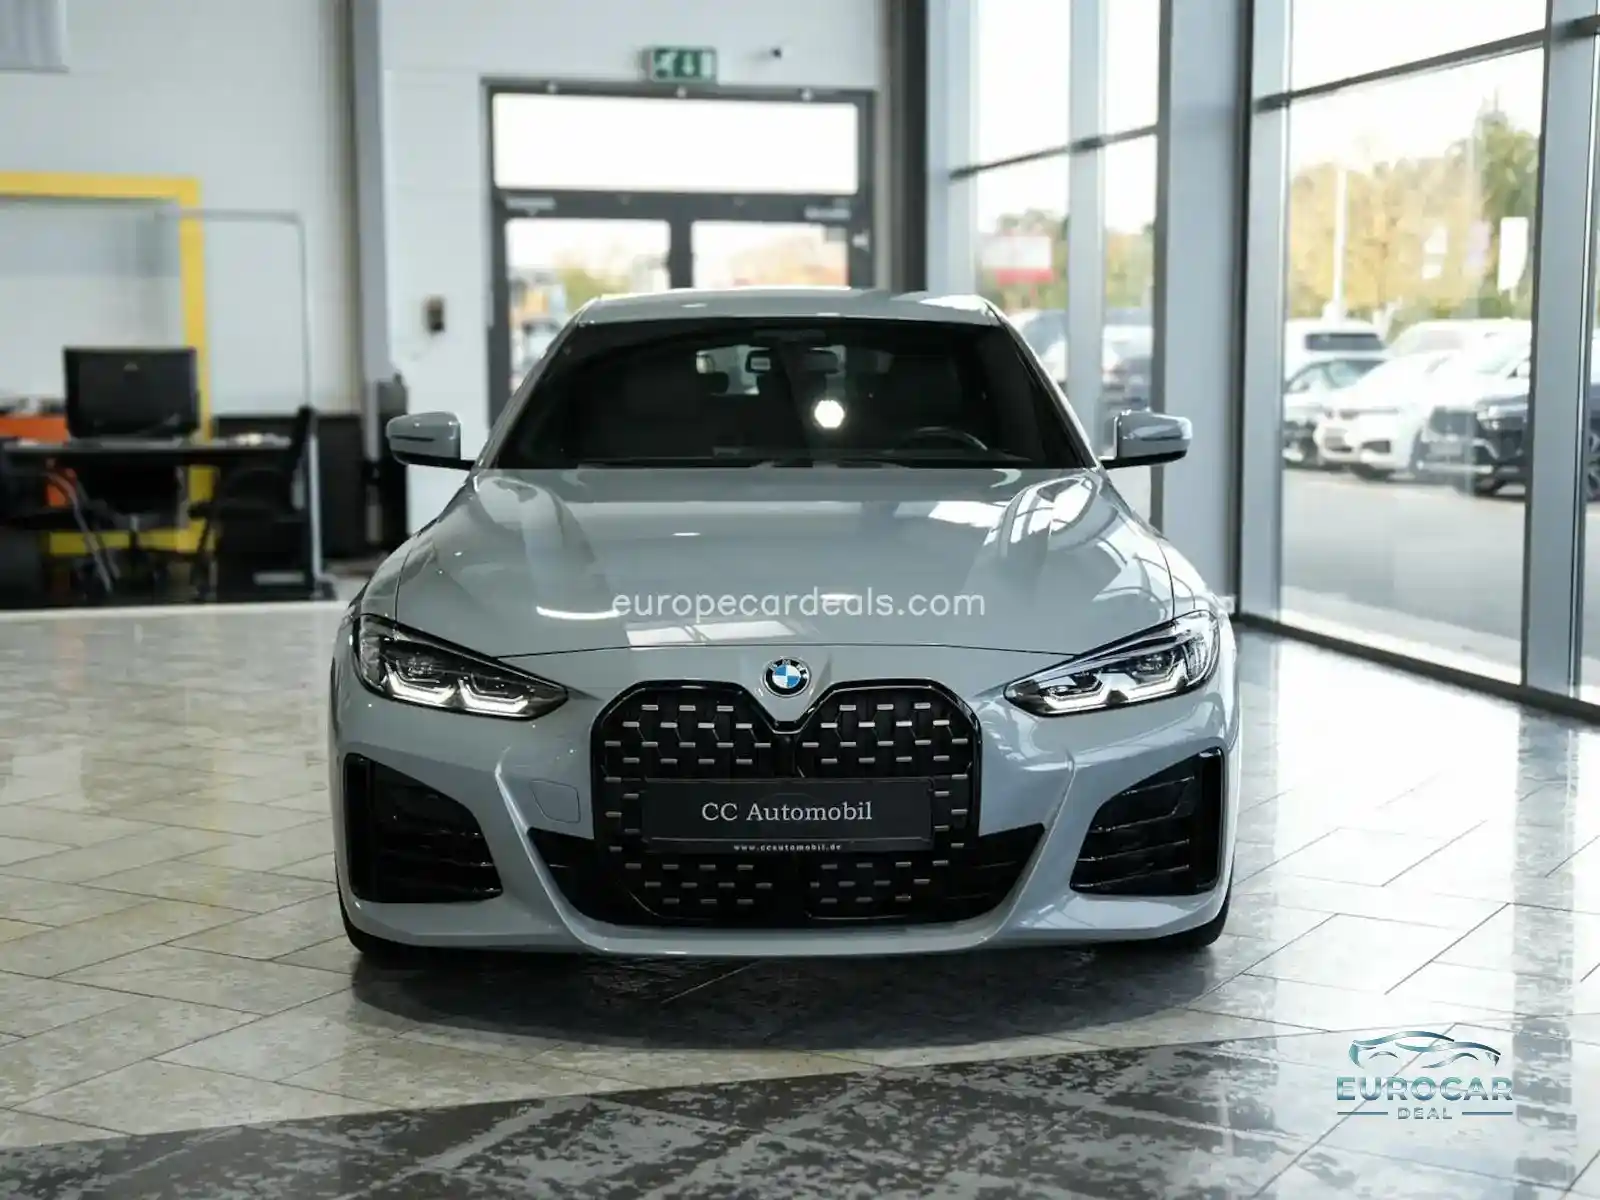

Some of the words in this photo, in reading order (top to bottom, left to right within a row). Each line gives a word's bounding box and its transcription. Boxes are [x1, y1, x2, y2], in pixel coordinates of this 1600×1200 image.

[701, 801, 738, 821] CC
[745, 800, 873, 821] Automobil
[733, 843, 842, 851] www.ccautomobil.de
